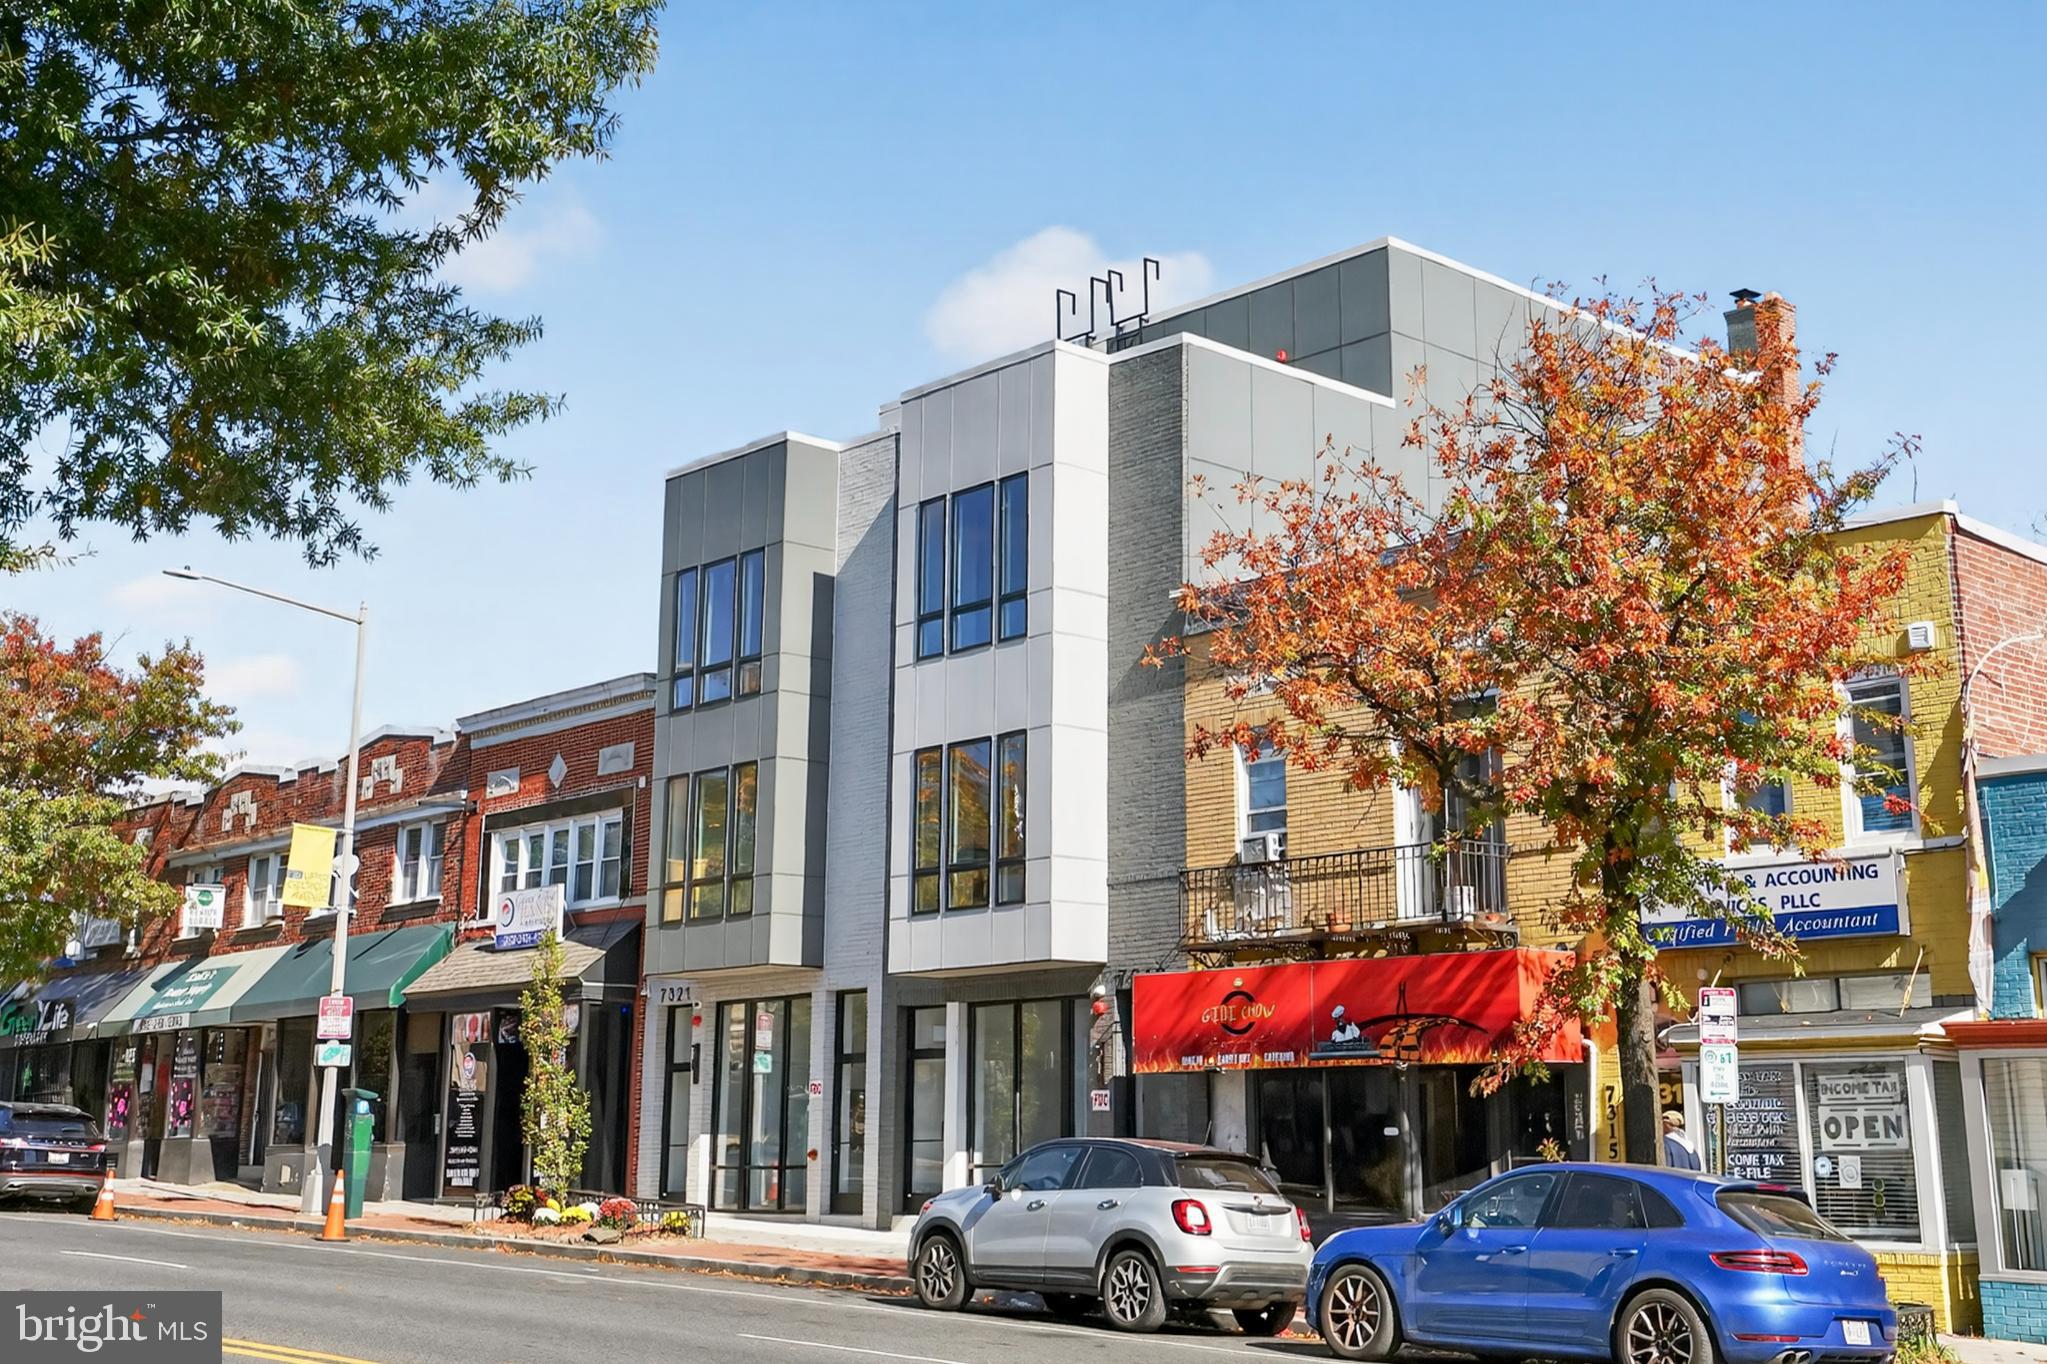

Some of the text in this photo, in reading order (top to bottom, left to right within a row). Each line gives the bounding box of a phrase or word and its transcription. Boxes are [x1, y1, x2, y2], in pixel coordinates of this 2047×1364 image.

[1781, 893, 1821, 911] PLLC
[1646, 923, 1715, 947] Ctified
[1783, 913, 1878, 934] Accountant
[660, 986, 692, 1003] 7321
[1821, 1082, 1870, 1096] INCOME
[1605, 1085, 1619, 1160] 7315
[1824, 1115, 1904, 1140] OPEN
[1728, 1154, 1760, 1167] COME
